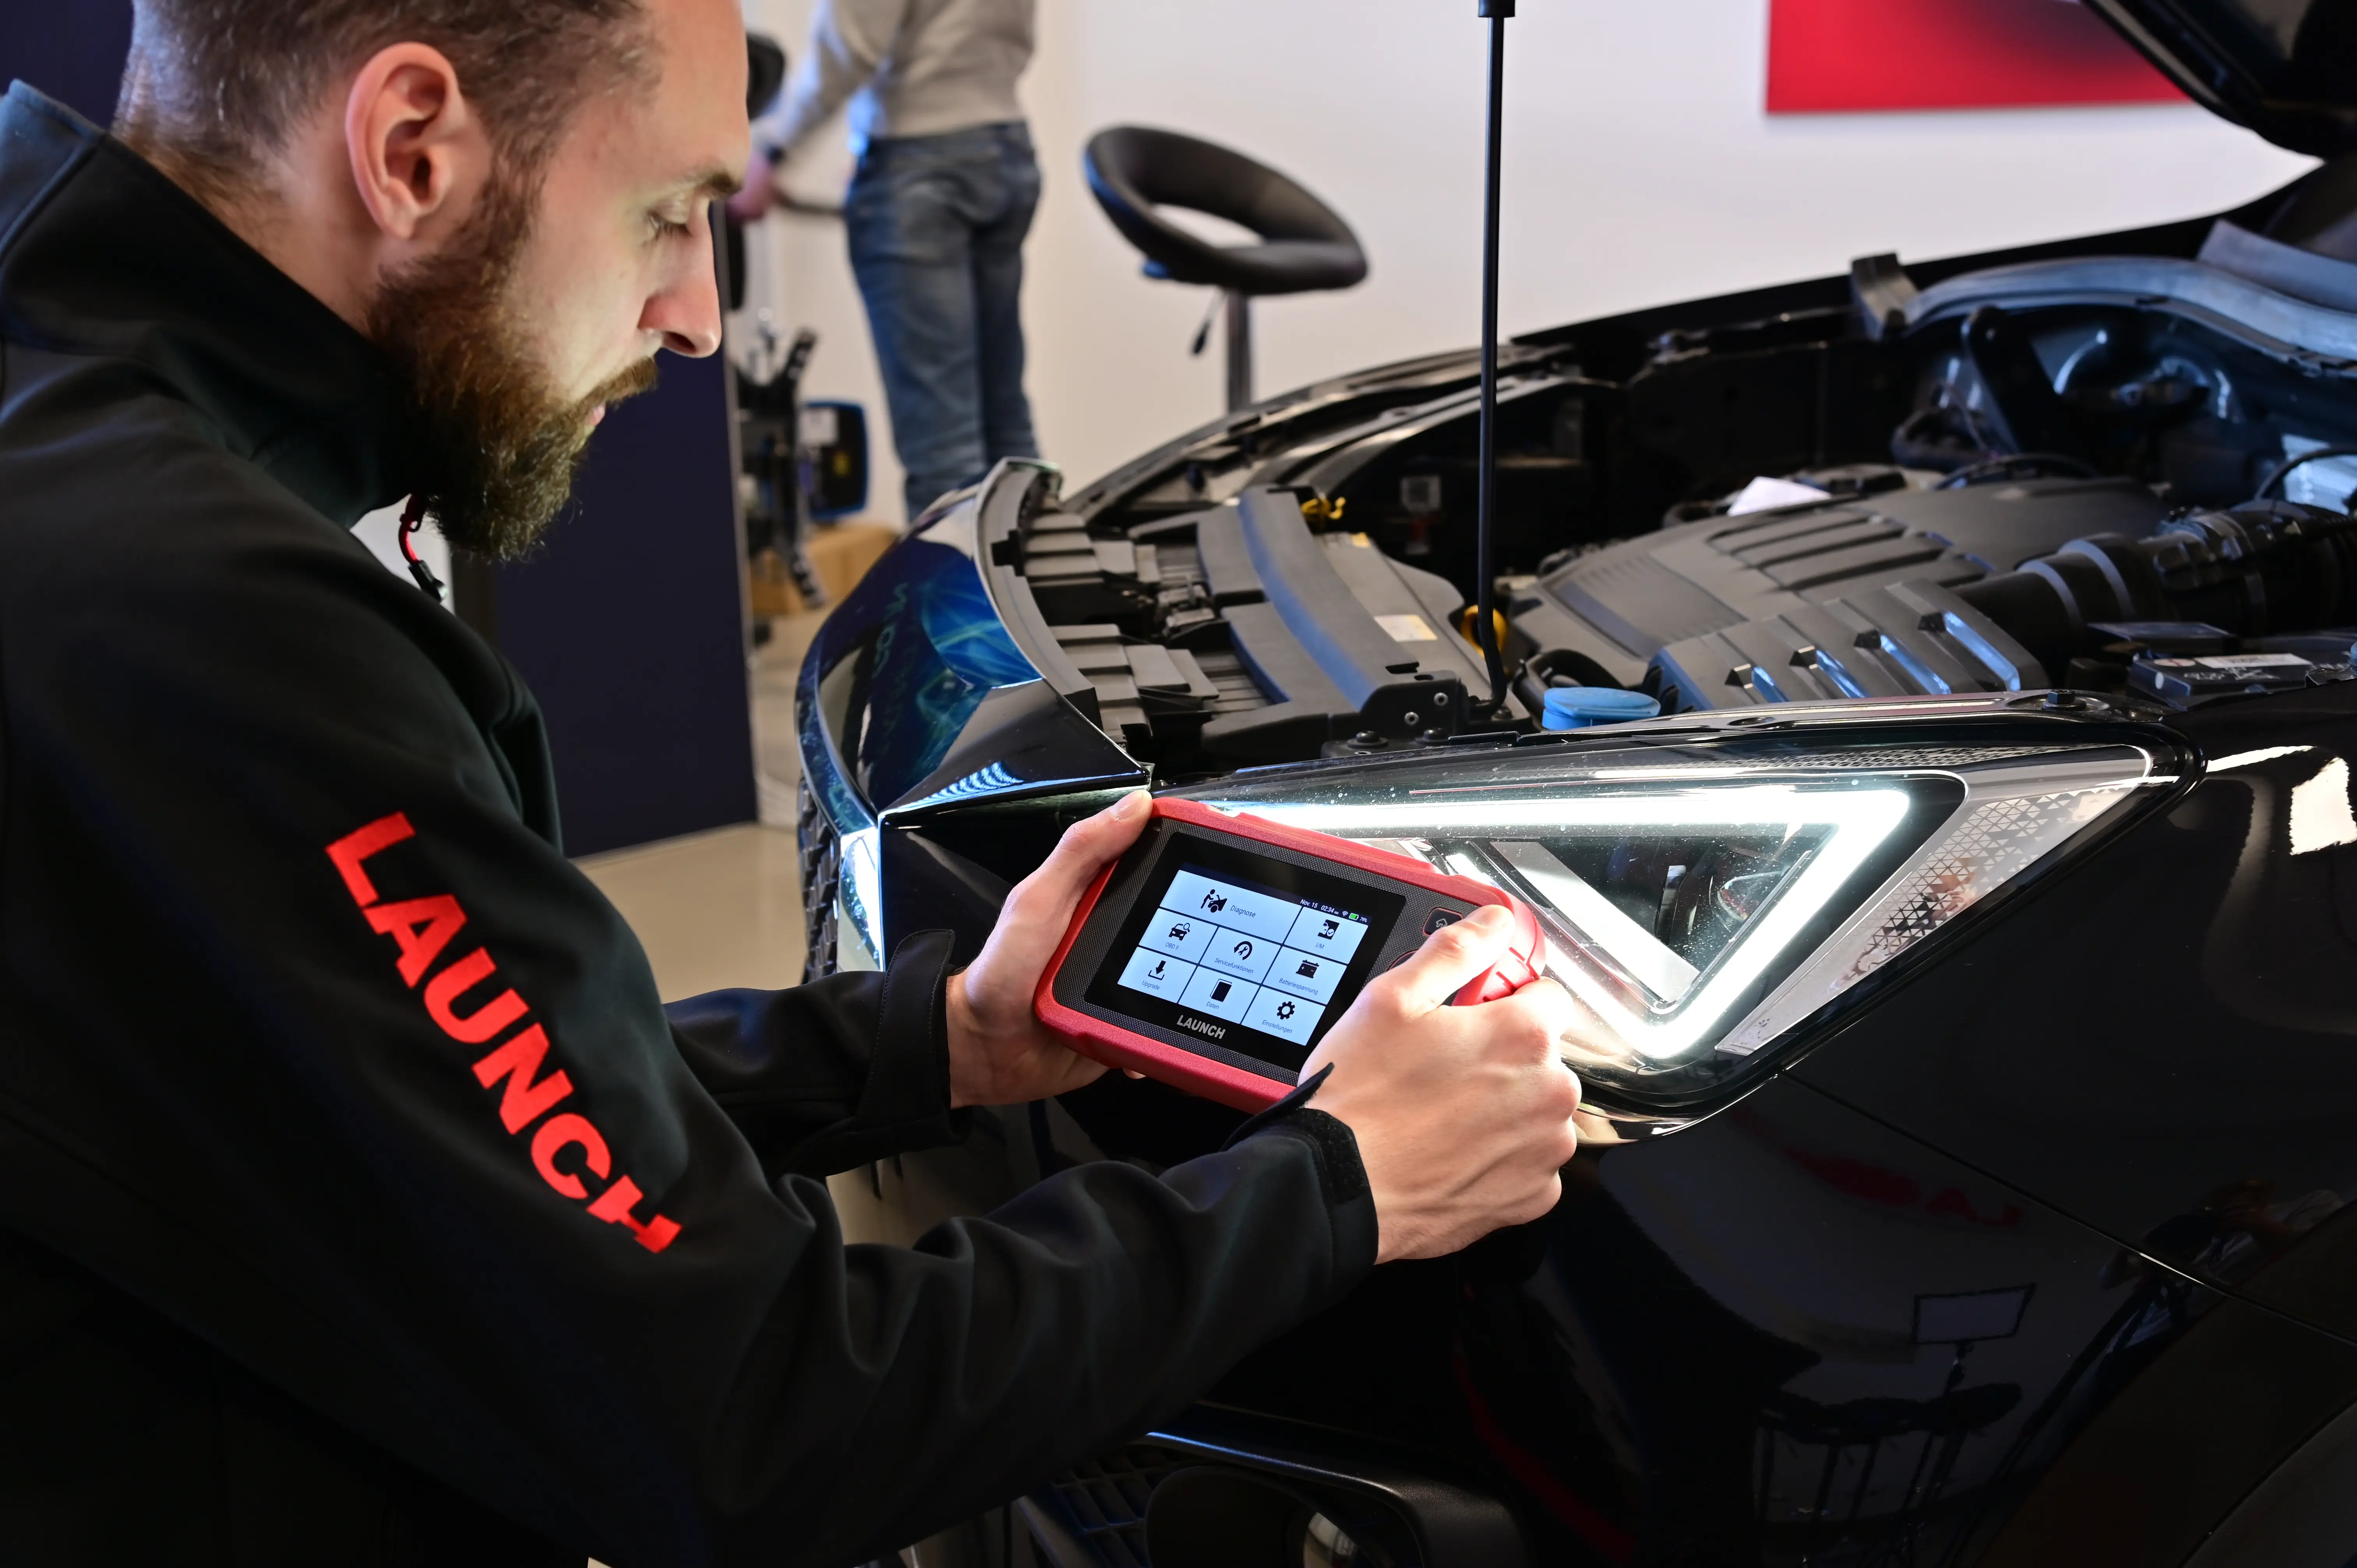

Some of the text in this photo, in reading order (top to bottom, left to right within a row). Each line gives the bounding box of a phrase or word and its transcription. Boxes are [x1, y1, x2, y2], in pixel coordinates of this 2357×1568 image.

[1230, 905, 1256, 918] Diagnose
[1214, 957, 1253, 974] Servicefunktionen
[1142, 980, 1160, 990] Upgrade
[1279, 978, 1318, 995] Batteriespannung
[325, 811, 682, 1254] LAUNCH
[1177, 1015, 1226, 1039] LAUNCH
[1262, 1019, 1292, 1034] Einstellungen
